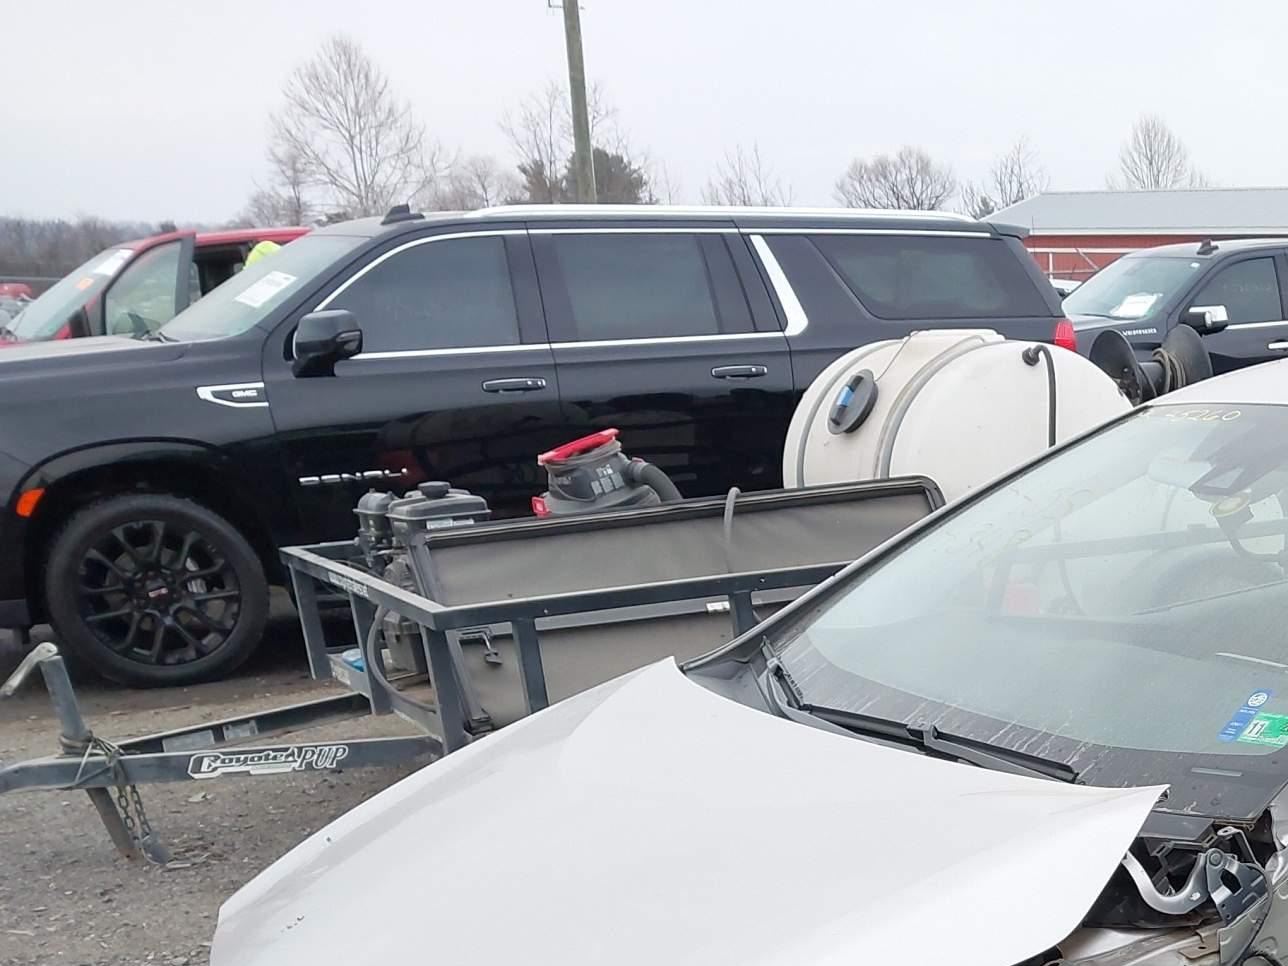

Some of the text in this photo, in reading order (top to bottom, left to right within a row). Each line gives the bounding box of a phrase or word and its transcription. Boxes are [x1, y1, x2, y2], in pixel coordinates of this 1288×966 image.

[231, 389, 258, 398] GMC
[1247, 721, 1267, 736] 11
[296, 745, 349, 771] PUP
